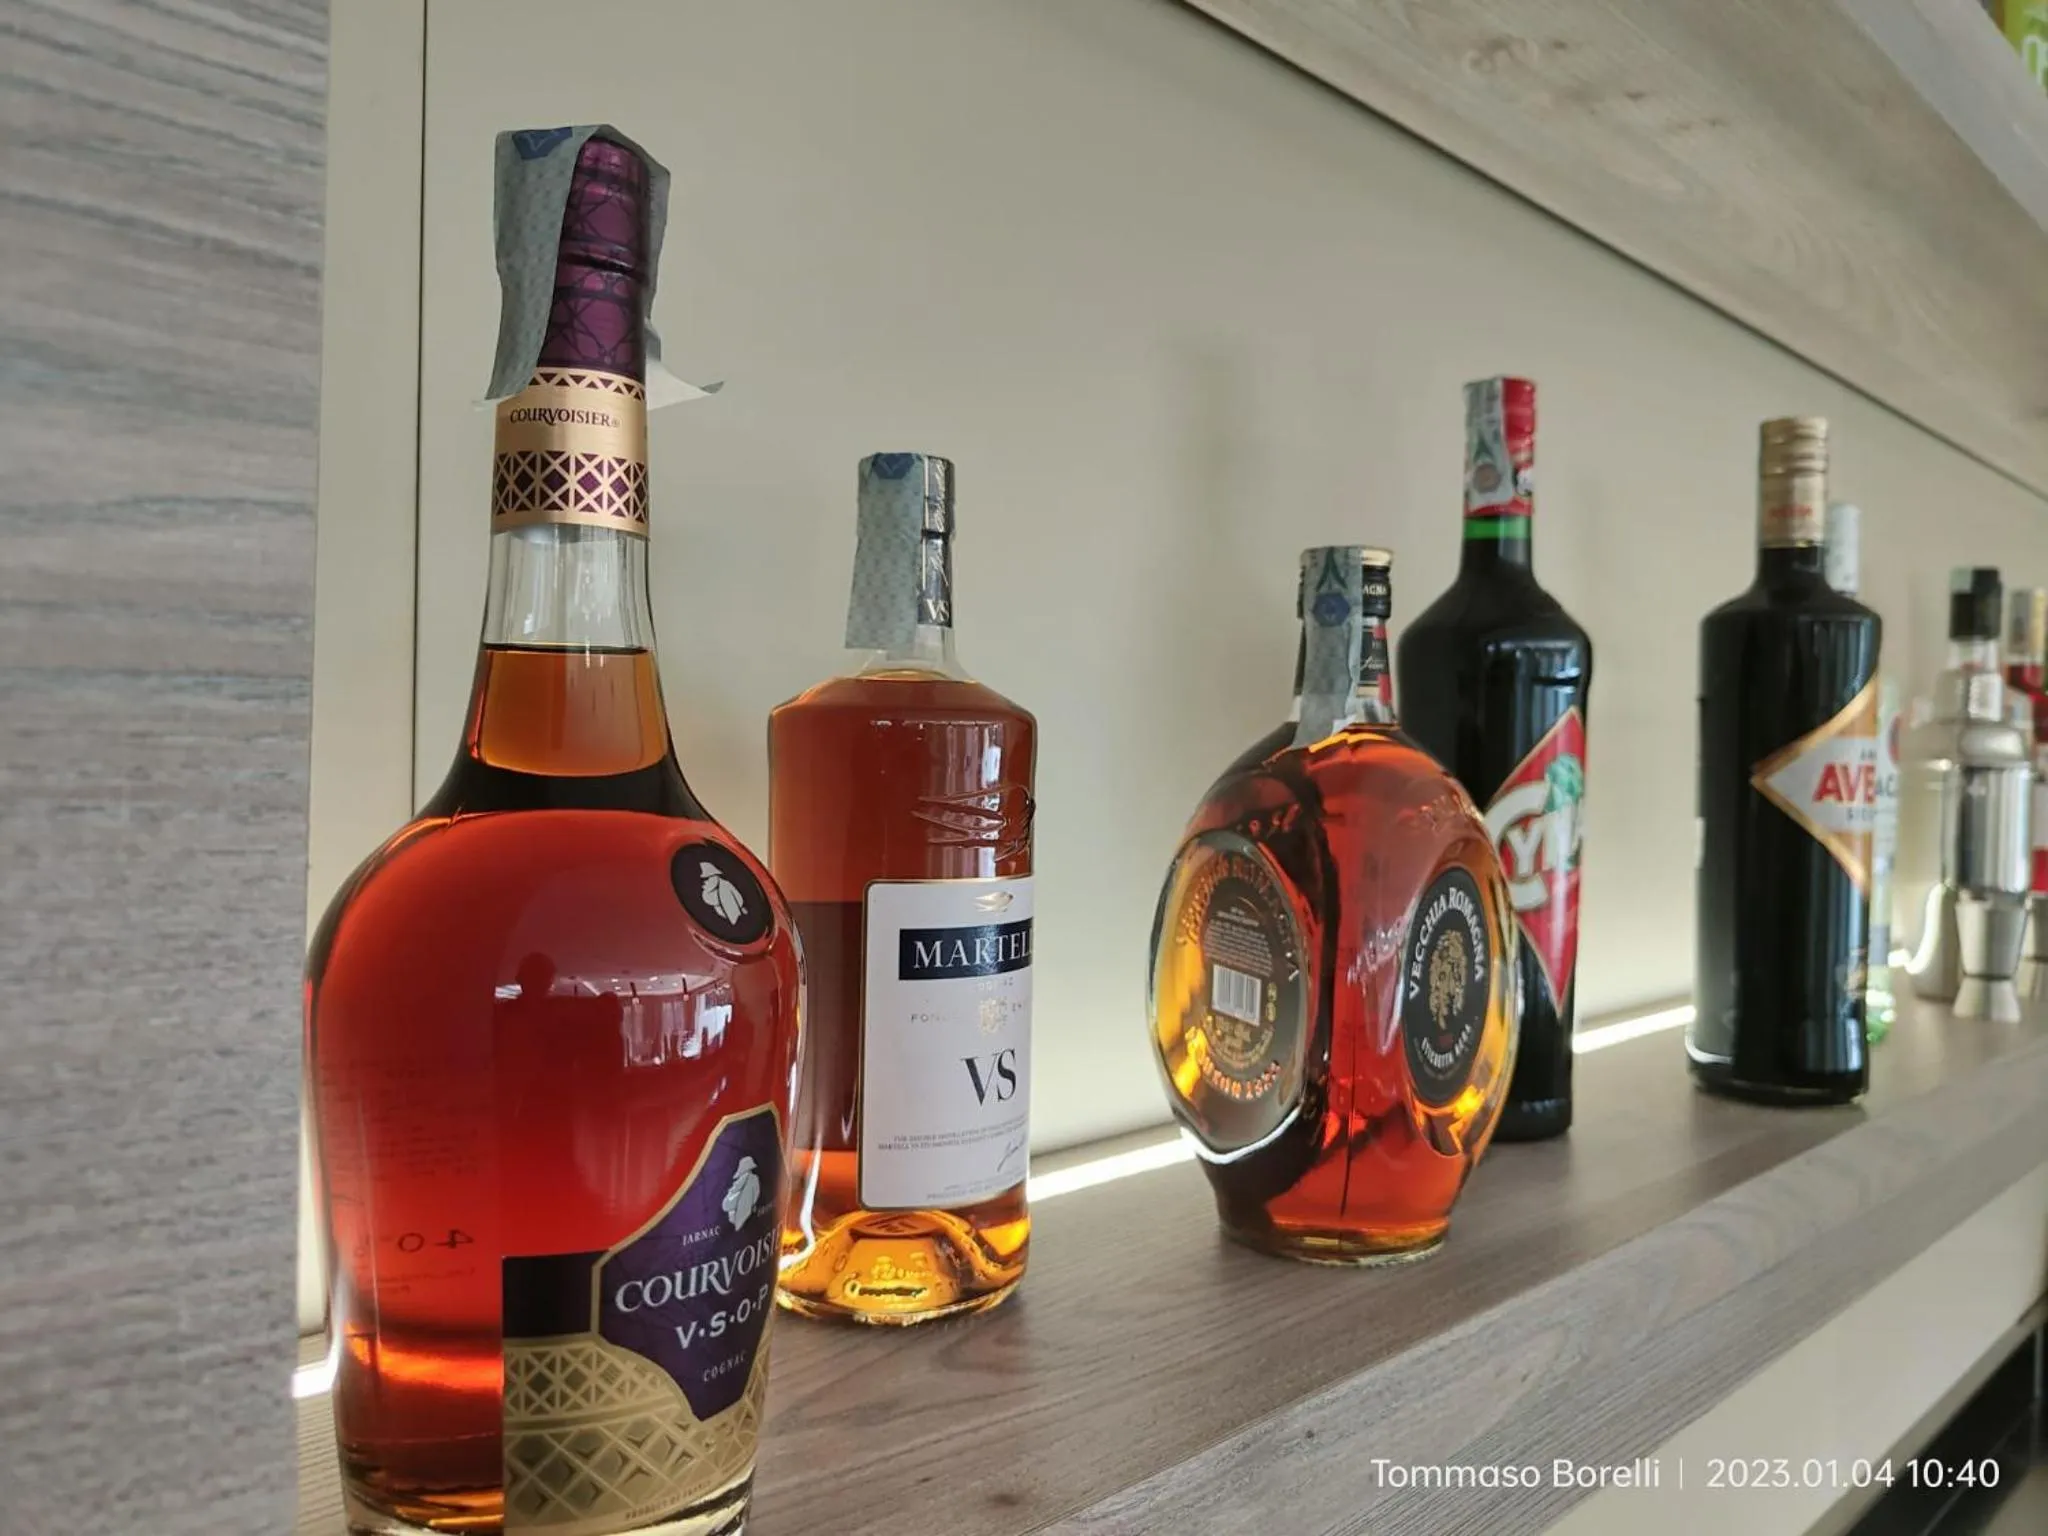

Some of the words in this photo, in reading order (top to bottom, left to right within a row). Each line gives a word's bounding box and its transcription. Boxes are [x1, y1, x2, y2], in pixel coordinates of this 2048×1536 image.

[1409, 894, 1448, 1000] VECCHIA
[1447, 886, 1485, 983] ROMAGNA
[960, 1047, 1017, 1107] VS
[682, 1225, 721, 1247] JARNAC
[702, 1350, 748, 1383] COGNAC
